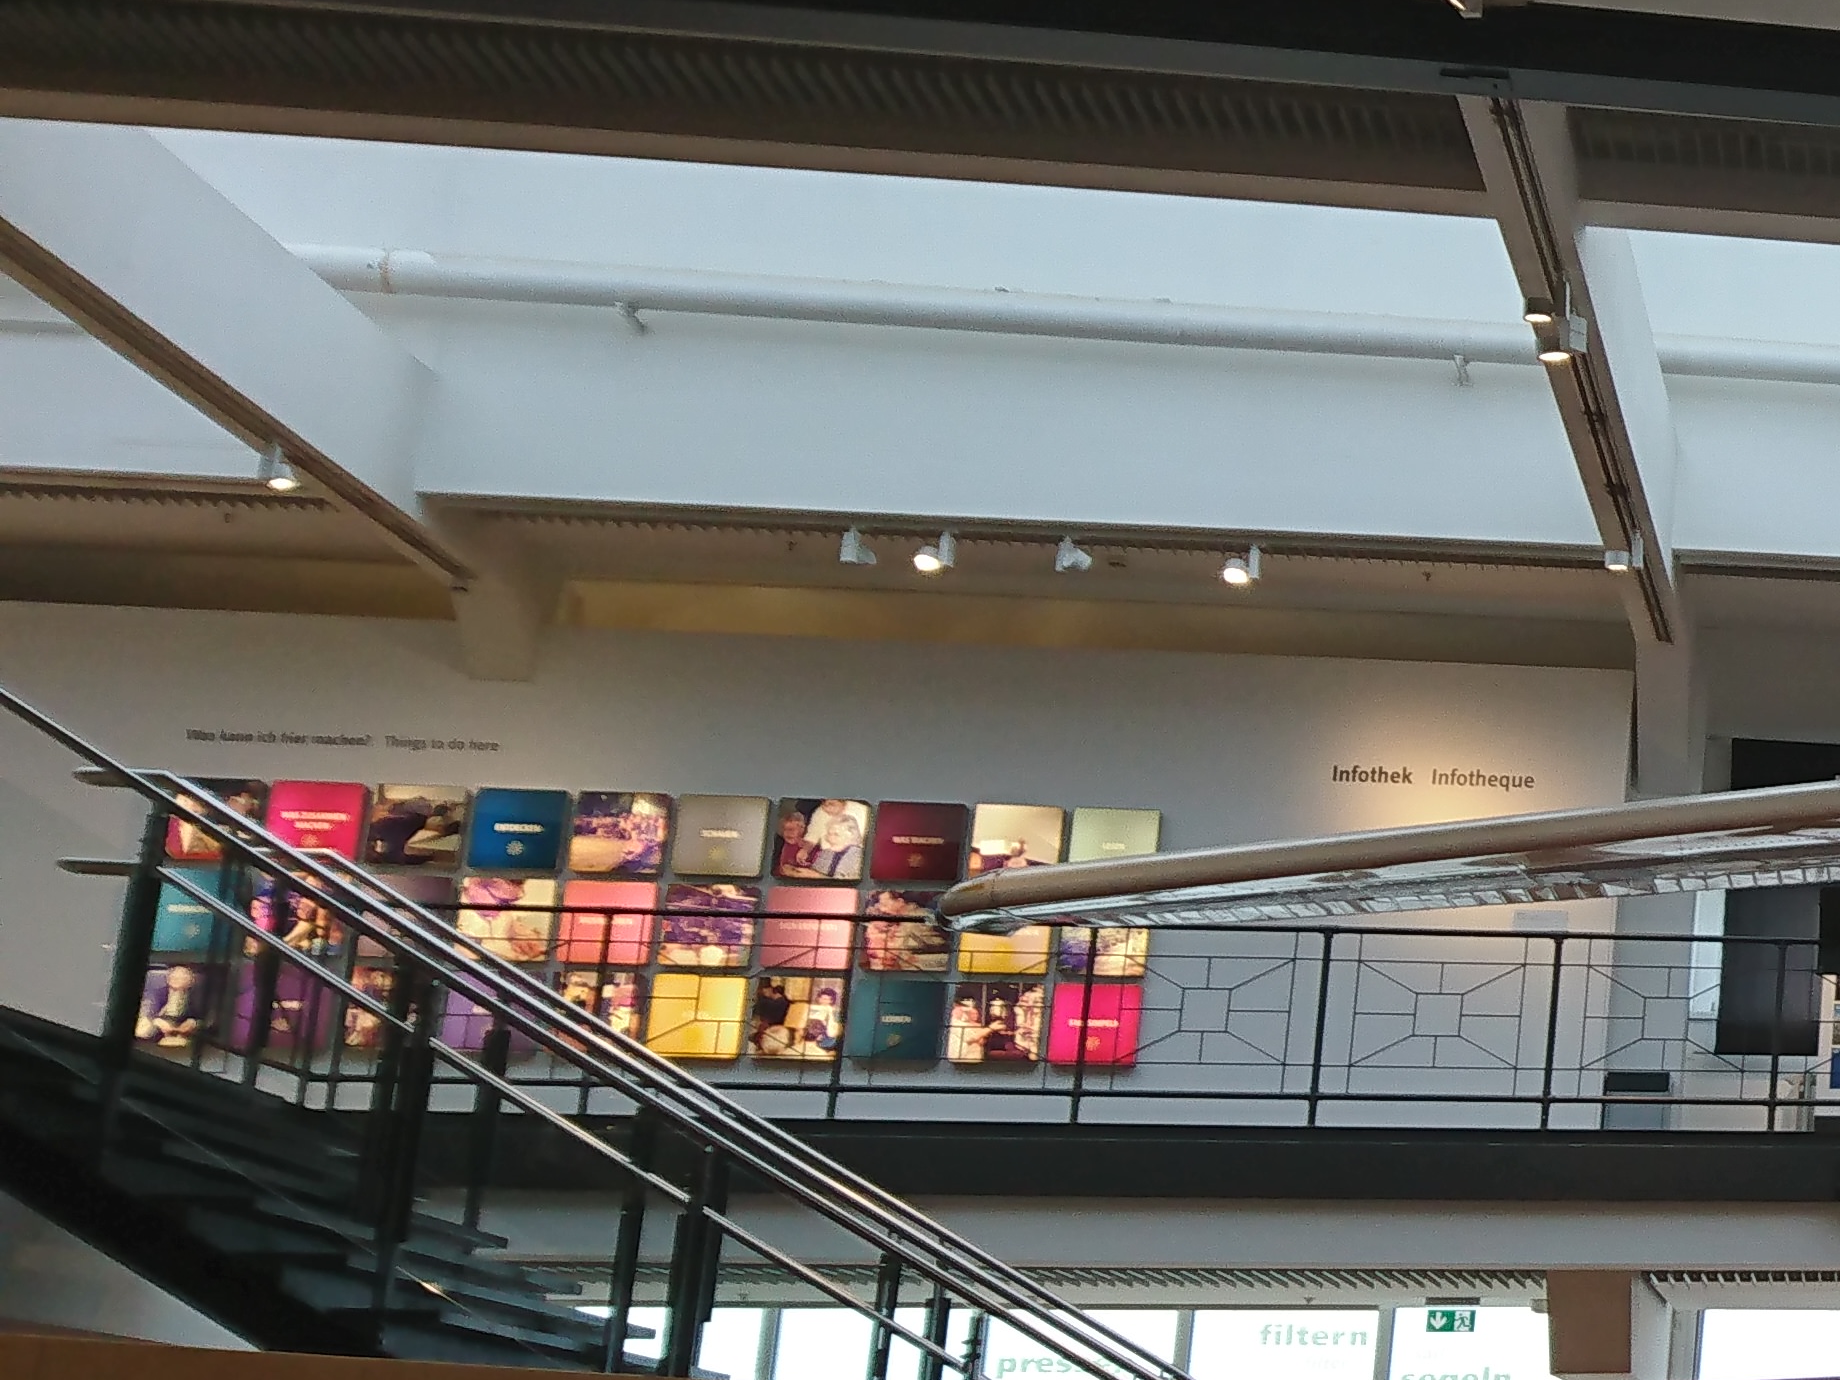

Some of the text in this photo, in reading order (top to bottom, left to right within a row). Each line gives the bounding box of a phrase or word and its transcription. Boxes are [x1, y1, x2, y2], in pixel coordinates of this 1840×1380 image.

[1332, 765, 1535, 792] Infothek Infotheque
[1259, 1324, 1370, 1347] filtern
